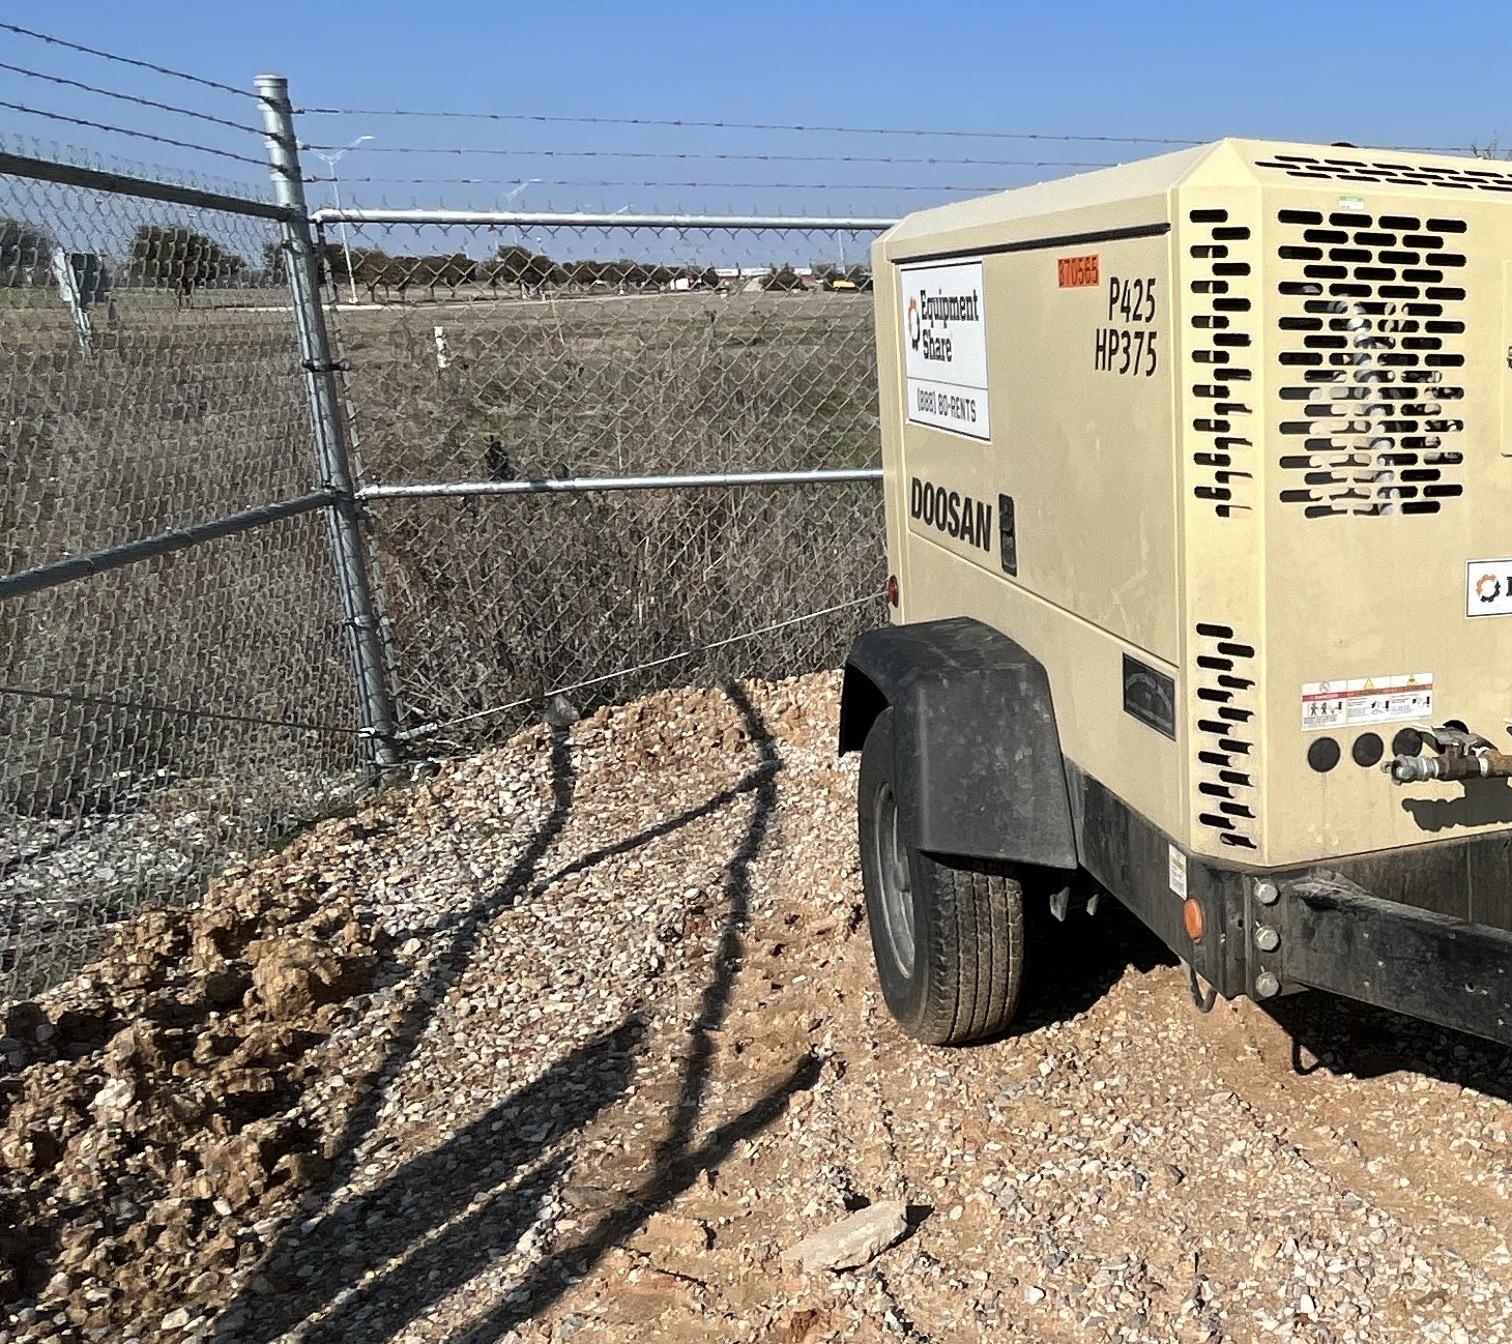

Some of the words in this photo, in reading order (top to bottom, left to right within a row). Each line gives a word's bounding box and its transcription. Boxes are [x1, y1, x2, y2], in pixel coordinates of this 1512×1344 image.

[920, 288, 979, 329] Equipment
[1108, 276, 1156, 323] P425
[922, 328, 953, 362] Share
[1094, 327, 1158, 377] HP375
[911, 476, 993, 553] DOOSAN
